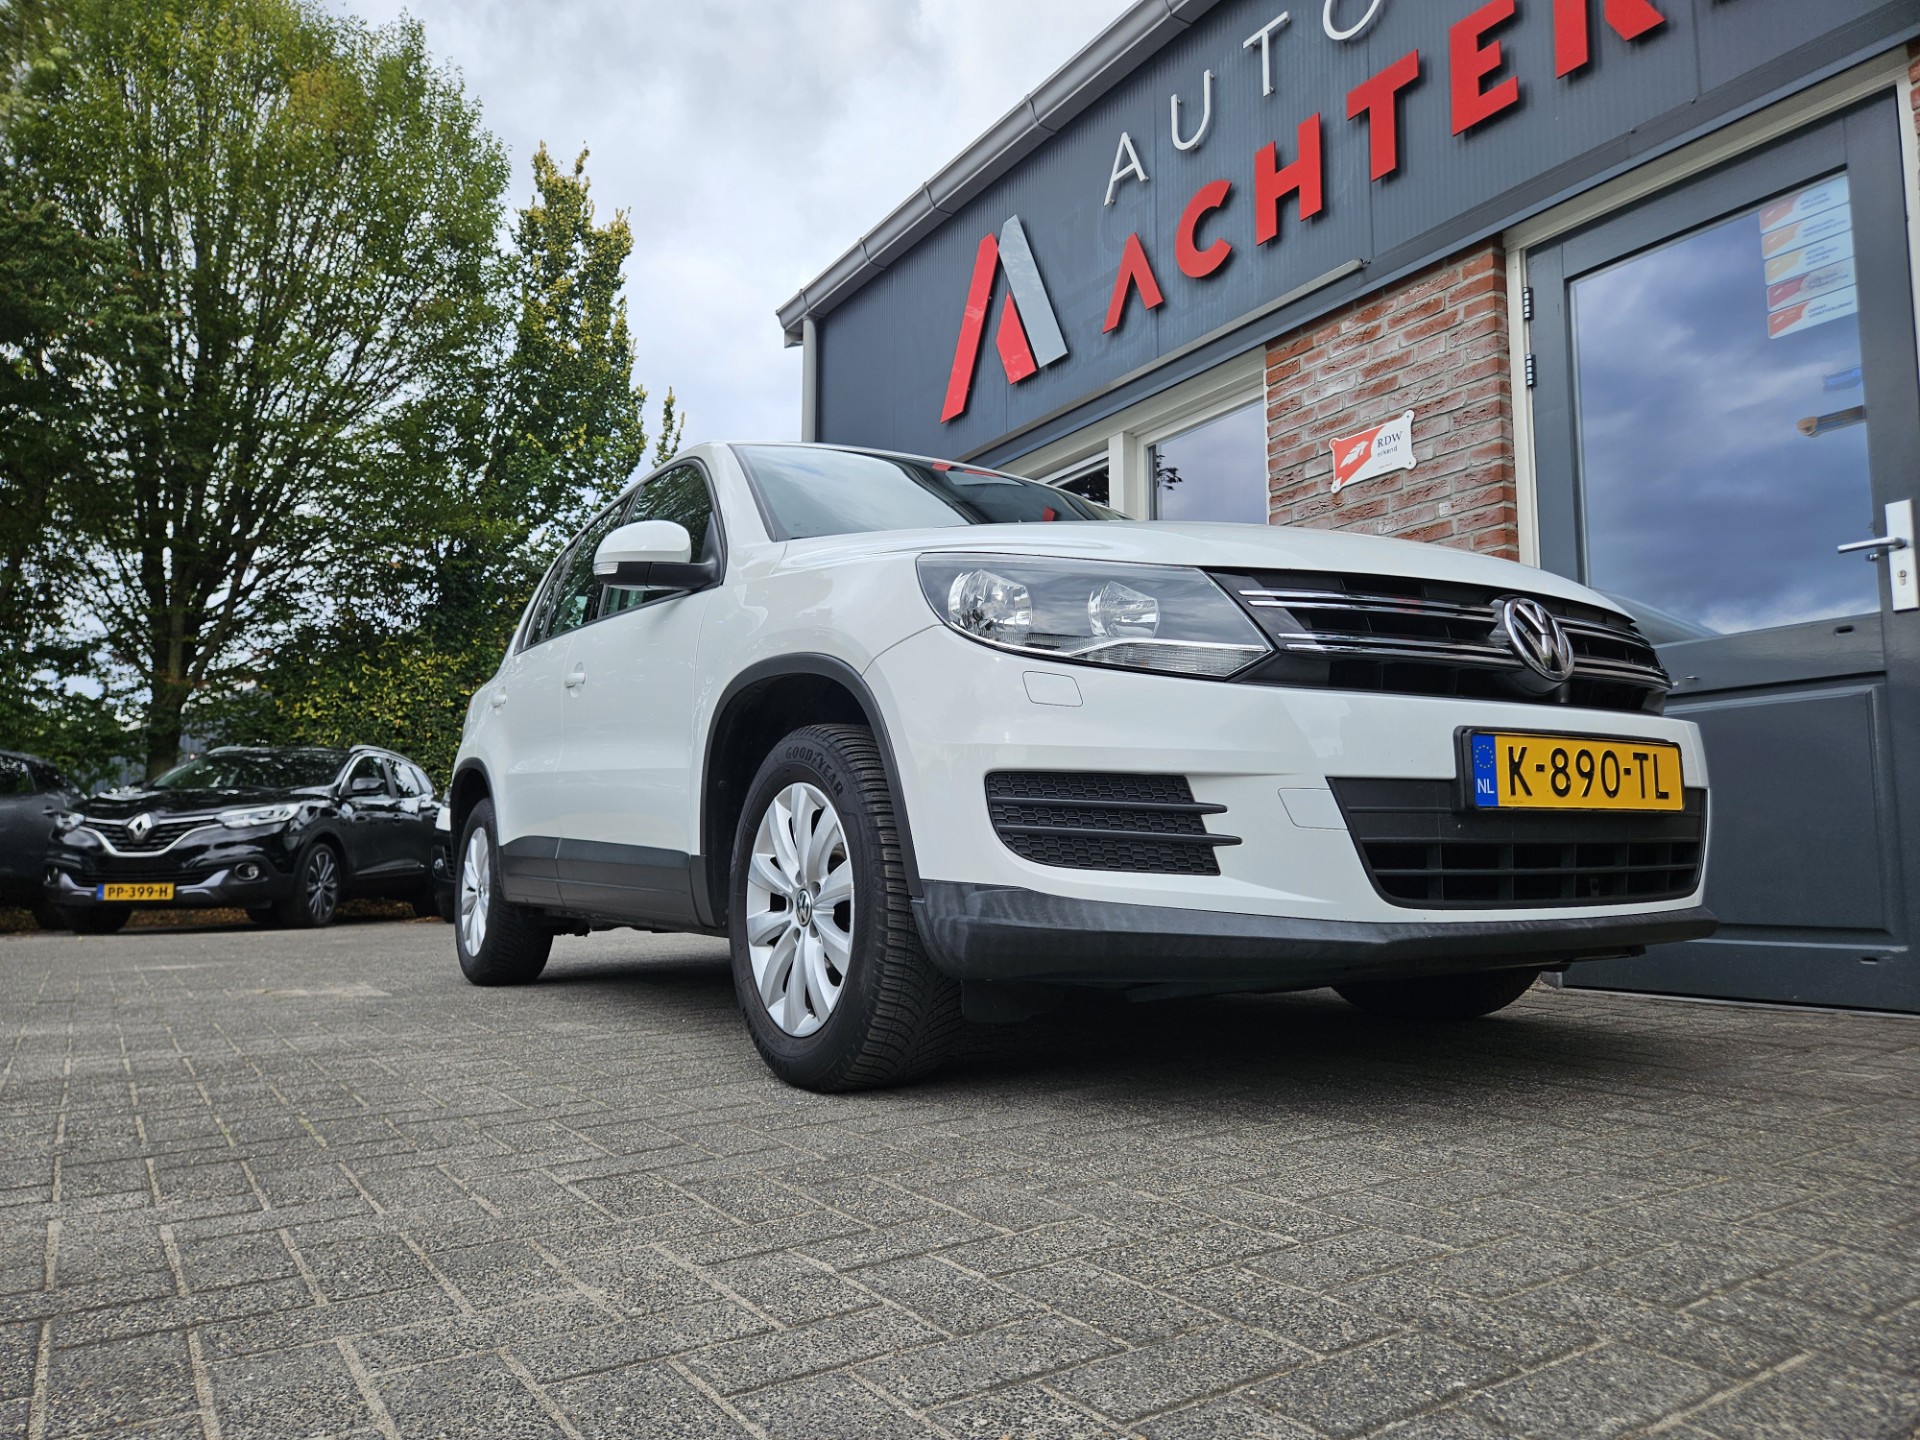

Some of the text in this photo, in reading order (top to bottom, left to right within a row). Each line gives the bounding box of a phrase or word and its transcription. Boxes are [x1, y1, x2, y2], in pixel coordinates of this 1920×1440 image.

[1377, 430, 1403, 448] RDW
[1377, 445, 1398, 458] erkend
[1477, 746, 1670, 800] NL K-890-TL
[108, 886, 168, 898] PP-399-H
